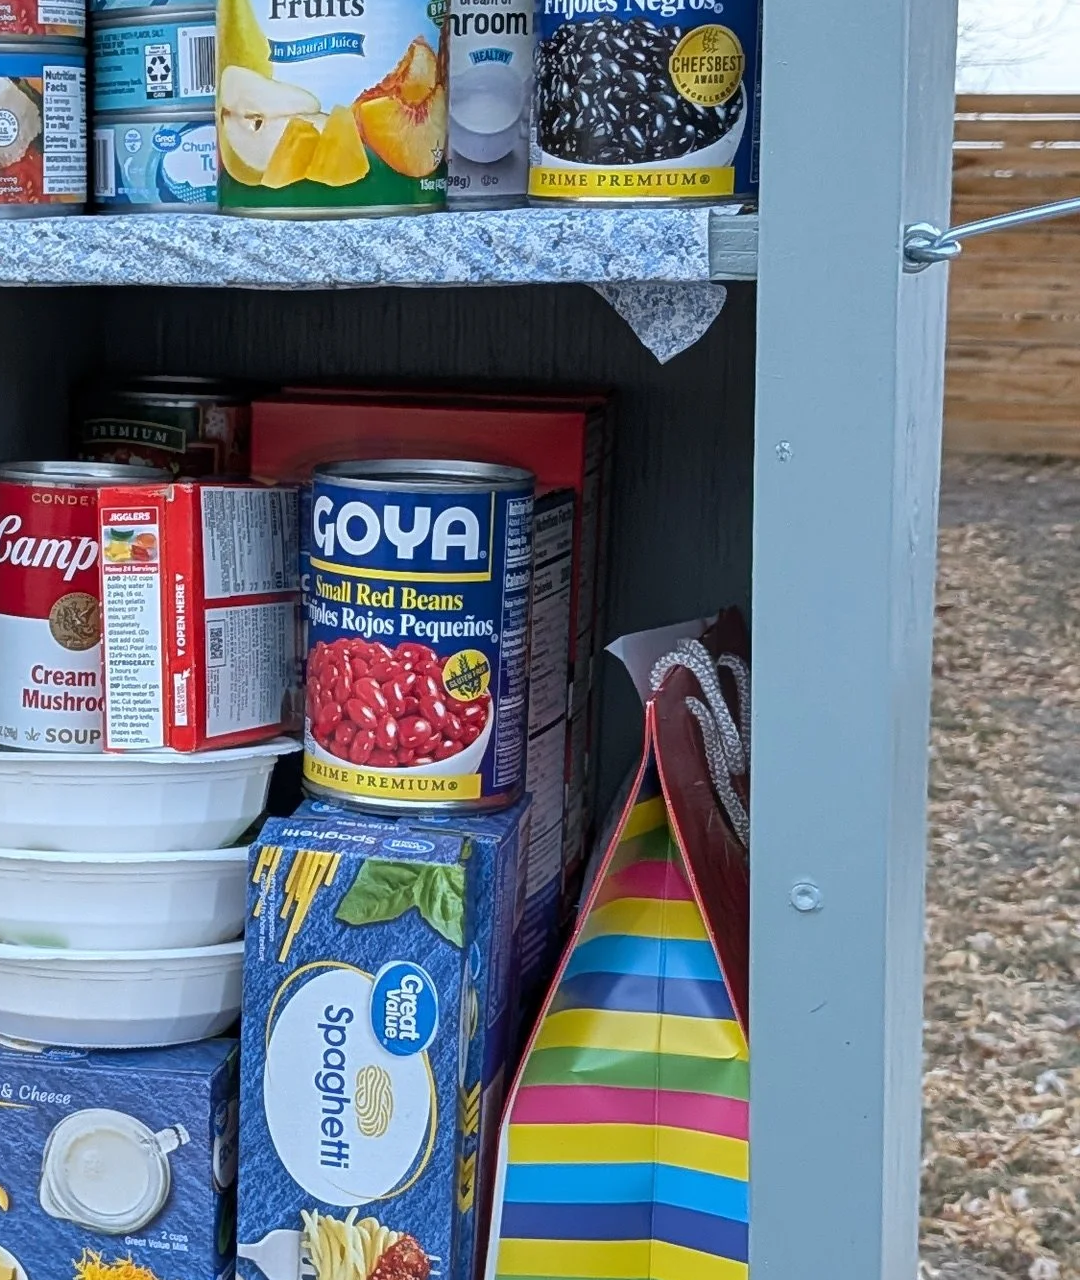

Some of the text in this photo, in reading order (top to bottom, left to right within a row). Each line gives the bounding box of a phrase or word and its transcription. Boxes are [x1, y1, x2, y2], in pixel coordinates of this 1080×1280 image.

[274, 35, 360, 58] in Natural Juice
[473, 50, 512, 63] HEALTHY
[671, 54, 744, 74] CHEFSBEST
[694, 73, 726, 85] AWARD
[540, 172, 588, 188] PRIME
[91, 422, 168, 444] PREMIUM
[312, 494, 481, 561] GOYA
[315, 574, 464, 613] Small Red Beans
[175, 584, 186, 647] OPEN HERE
[341, 606, 494, 644] Rojos Pequeños
[31, 663, 96, 687] Cream
[22, 688, 104, 712] Mushro
[45, 727, 101, 746] SOUP
[311, 761, 349, 783] PRIME
[281, 828, 377, 845] Spaghetti
[267, 902, 276, 942] suggestion
[384, 988, 401, 1039] Value
[399, 974, 424, 1042] Great
[0, 1083, 13, 1098] &
[19, 1085, 71, 1105] Cheese
[313, 1004, 355, 1170] Spaghetti
[124, 1236, 189, 1252] Great Value Milk
